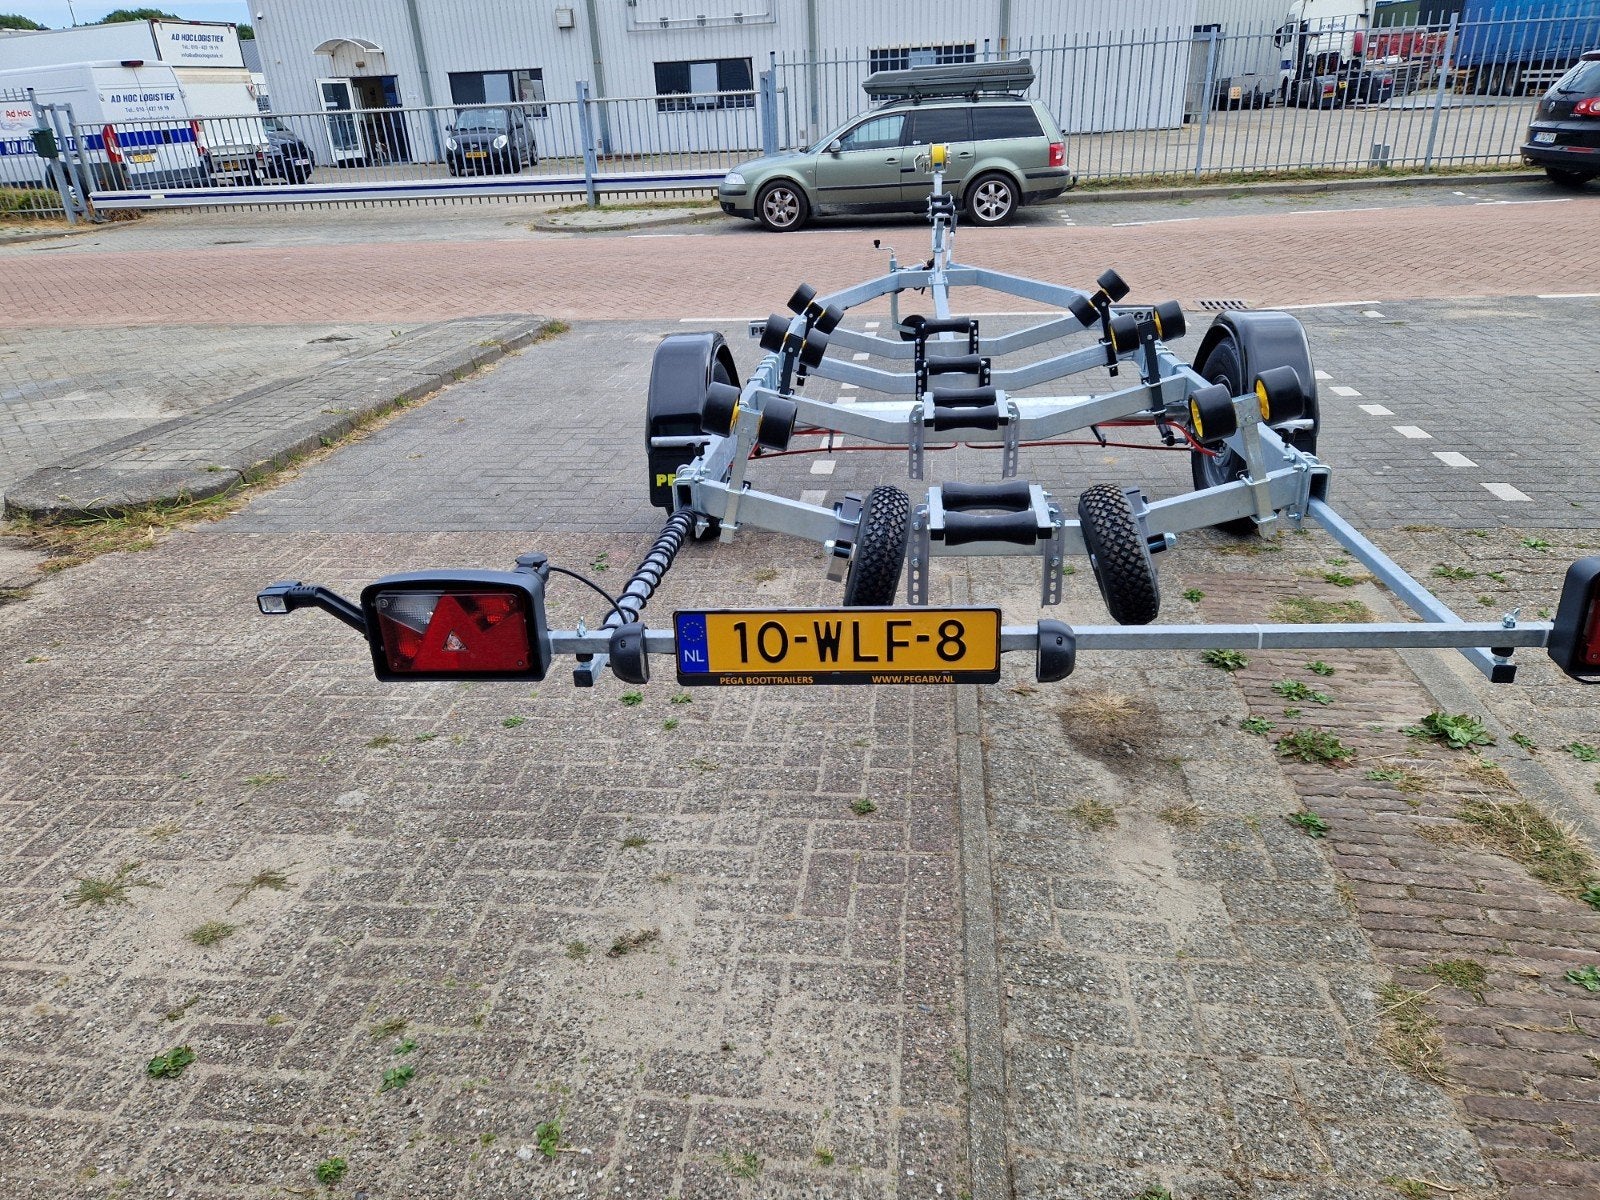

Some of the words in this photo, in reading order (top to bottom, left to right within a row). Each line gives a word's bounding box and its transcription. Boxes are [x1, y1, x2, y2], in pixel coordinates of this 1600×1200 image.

[171, 33, 180, 41] AD
[194, 34, 224, 43] LOGISTIEK
[111, 94, 121, 103] AD
[123, 94, 138, 103] HOC
[139, 93, 175, 102] LOGISTIEK
[6, 110, 16, 118] Ad
[6, 141, 19, 154] AD
[733, 618, 967, 664] 10-WLF-8
[684, 649, 705, 663] NL
[719, 676, 744, 685] PEGA
[746, 676, 814, 685] BOOTTRAILERS
[871, 675, 956, 684] WWW.PEGABV.NL
